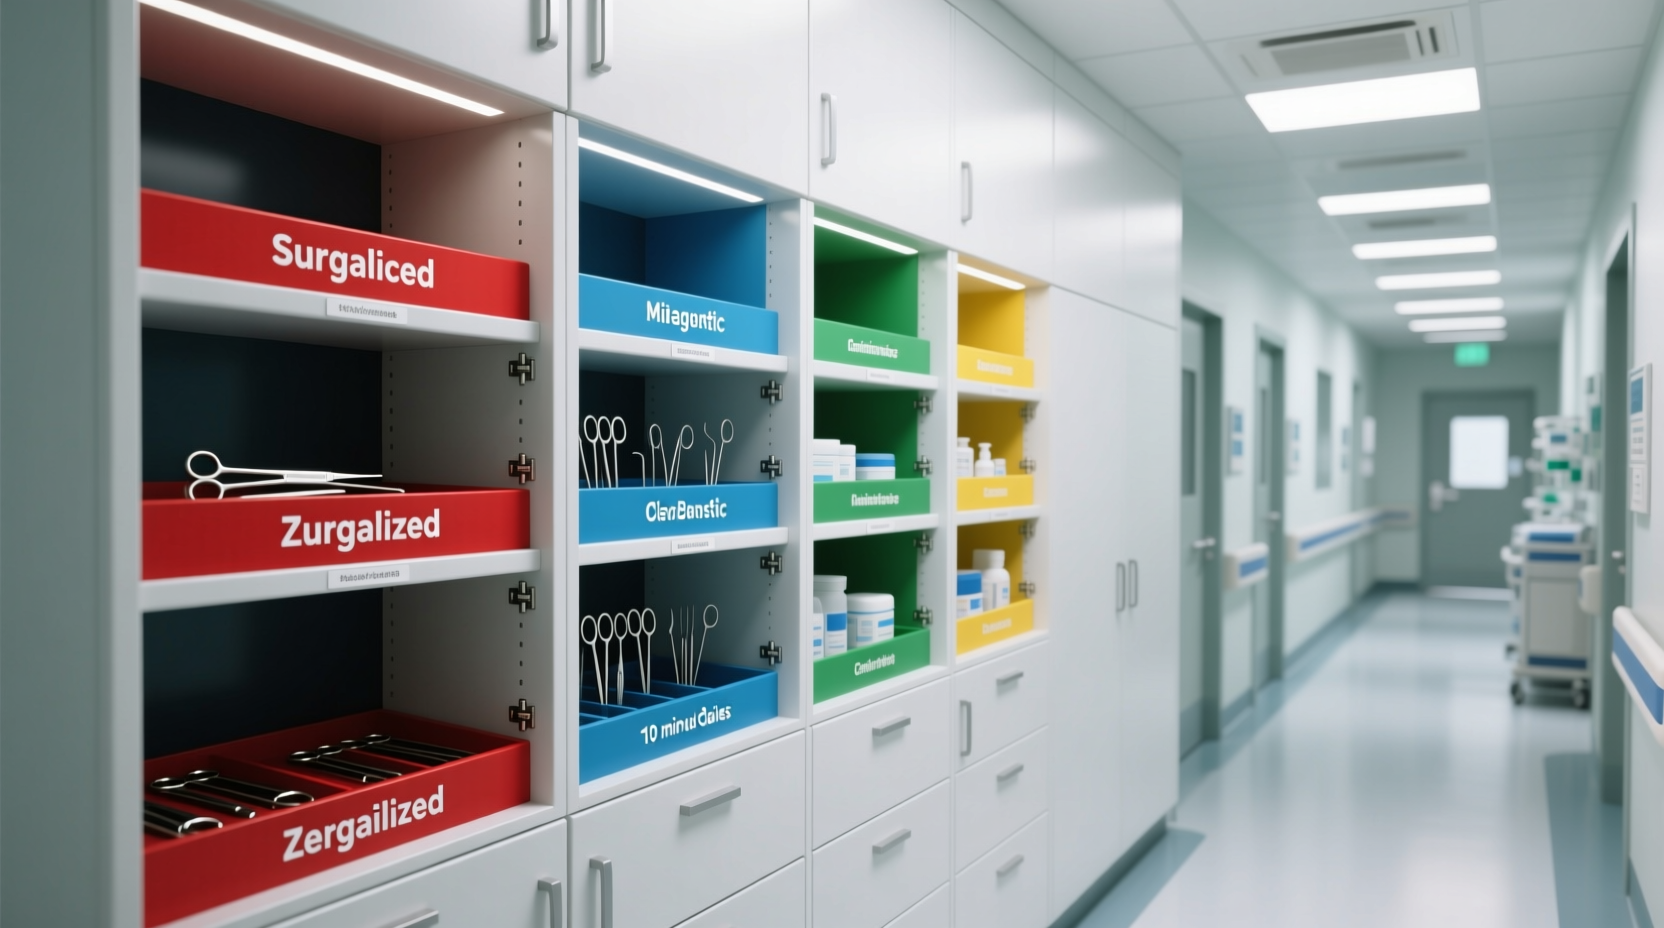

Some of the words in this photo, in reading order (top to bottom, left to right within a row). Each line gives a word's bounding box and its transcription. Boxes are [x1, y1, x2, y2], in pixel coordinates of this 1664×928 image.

[271, 233, 435, 289] Surgaliced
[281, 508, 440, 553] Zurgalized
[640, 724, 658, 745] 10
[282, 784, 444, 863] Zergailized
